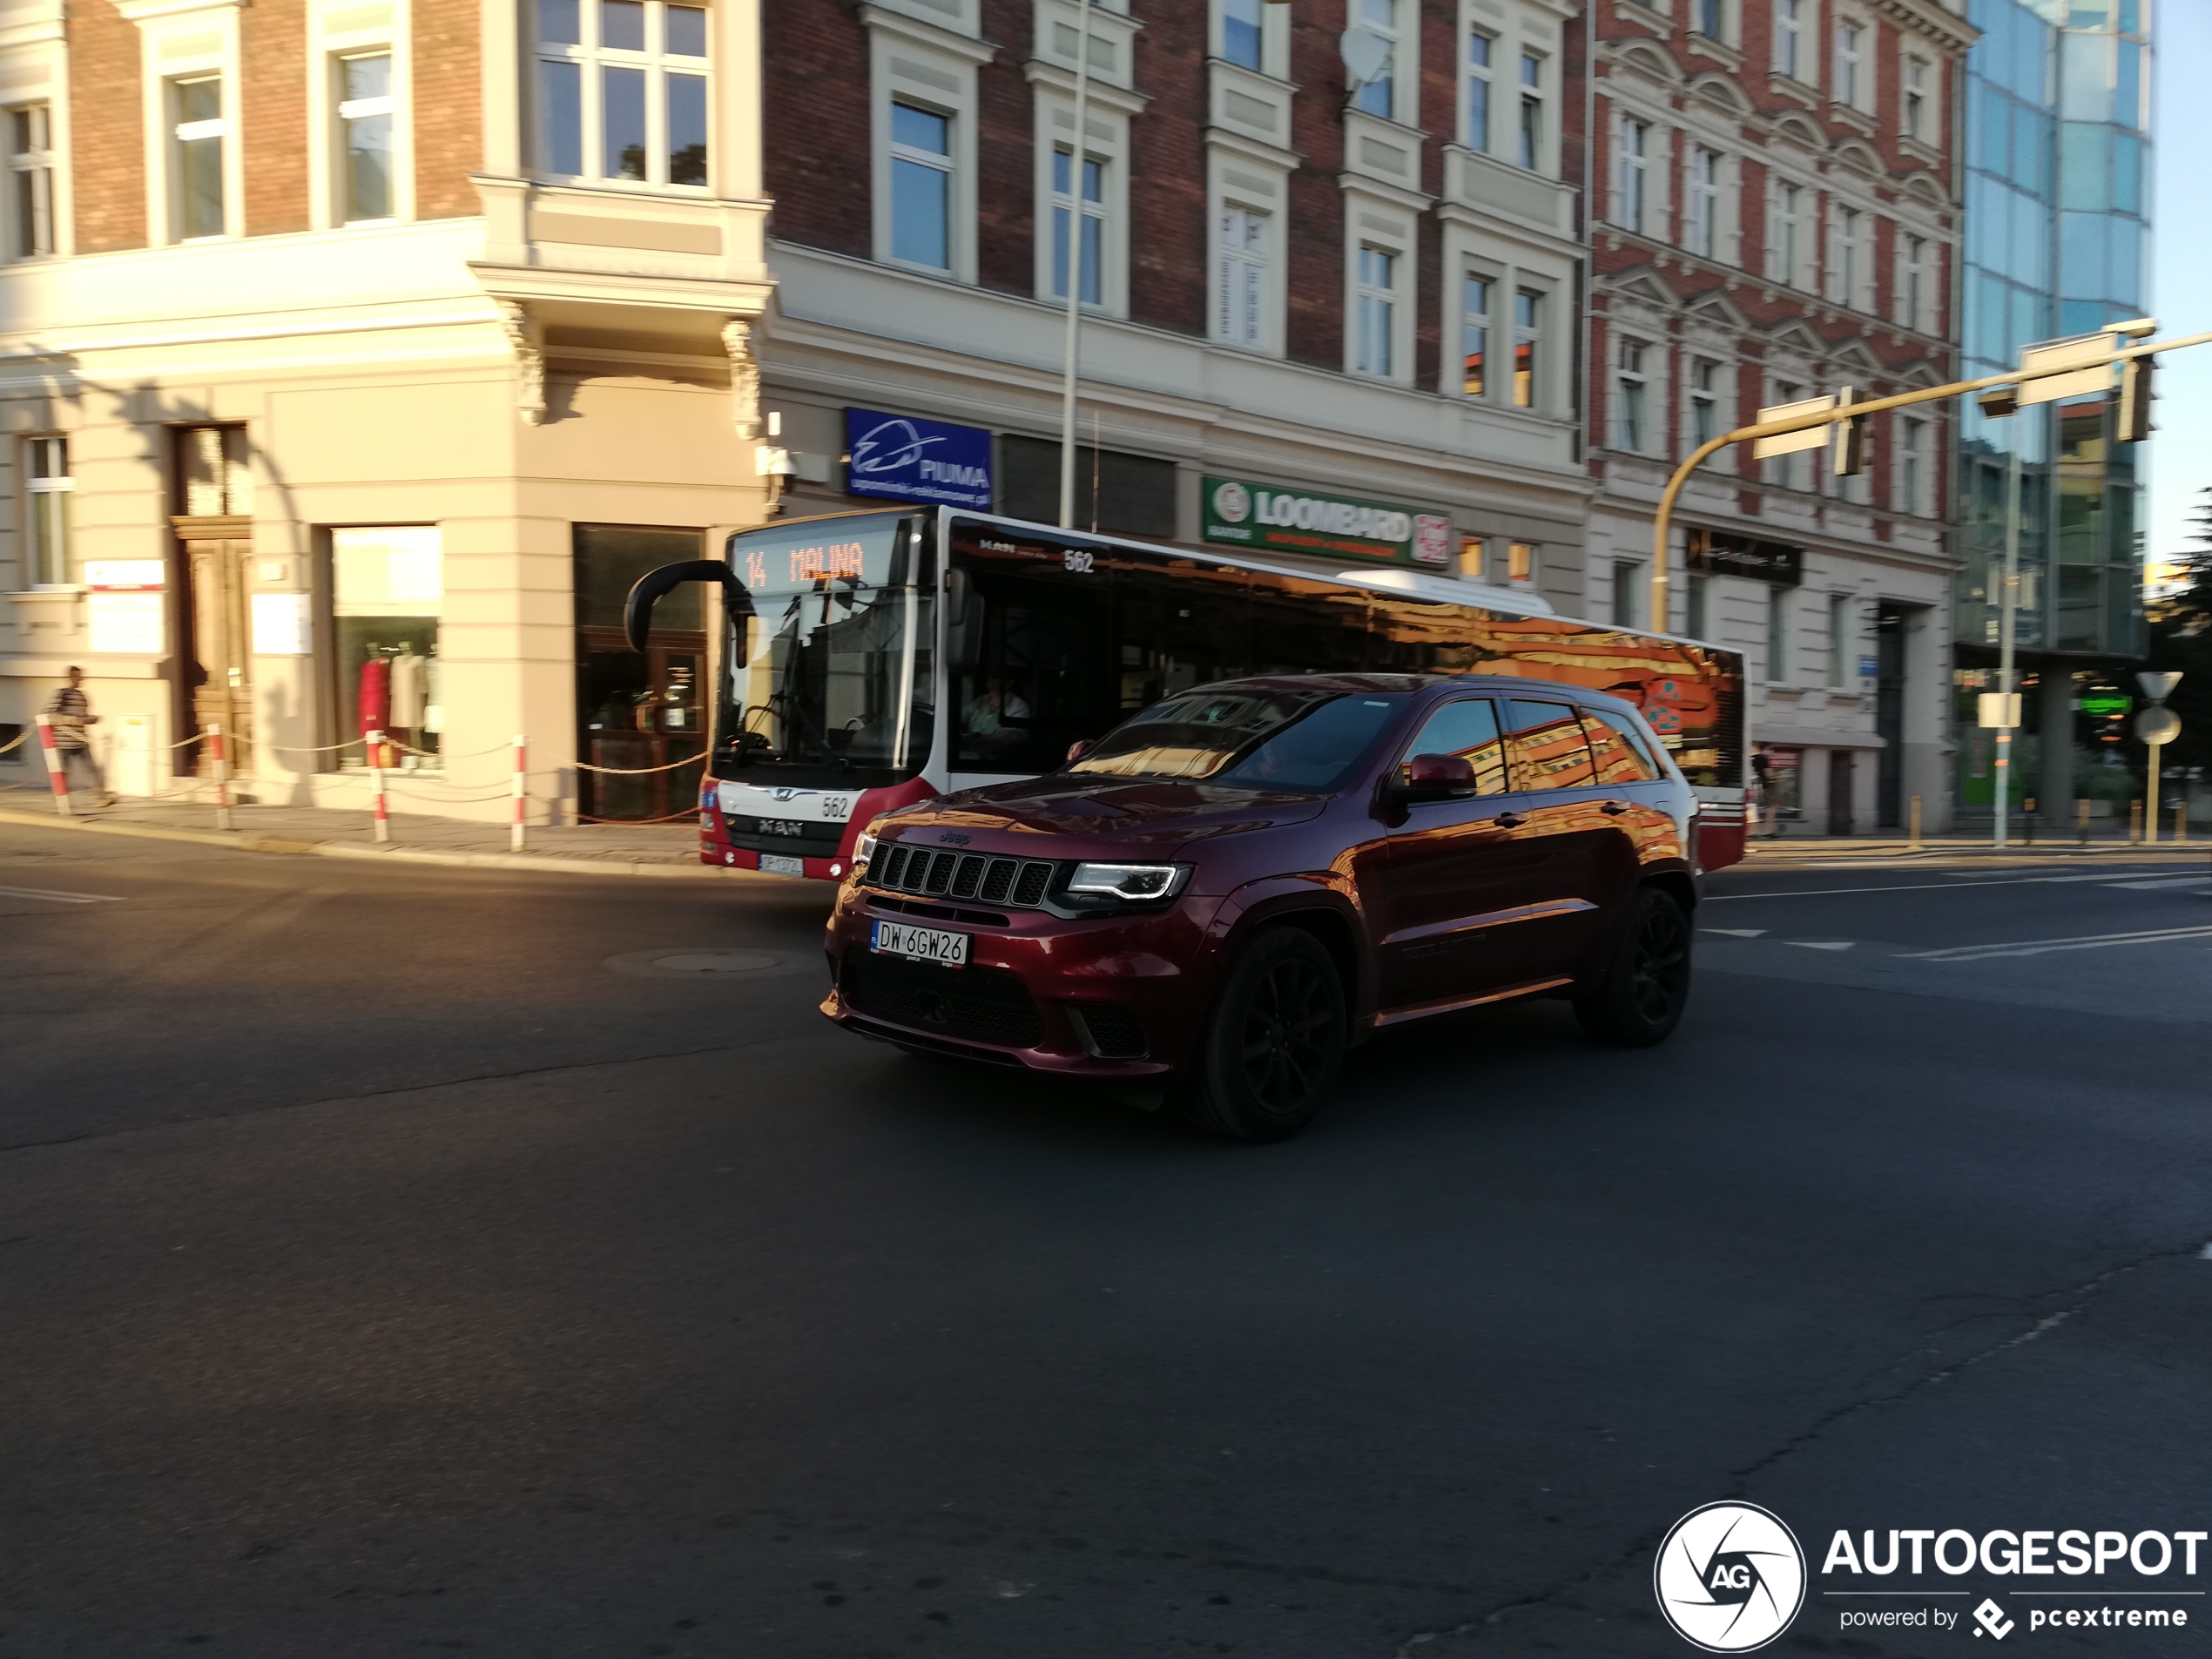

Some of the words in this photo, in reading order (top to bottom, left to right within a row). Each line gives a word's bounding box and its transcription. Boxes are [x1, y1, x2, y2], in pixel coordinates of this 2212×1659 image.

[920, 459, 989, 489] PIUMA
[1254, 491, 1413, 543] LOOMBARD
[745, 551, 766, 588] 14
[790, 542, 864, 582] MALINA
[1063, 550, 1095, 574] 562
[822, 797, 847, 818] 562
[759, 819, 804, 837] MAN
[939, 830, 972, 846] Jeep
[880, 924, 902, 950] DW
[907, 929, 963, 961] 6GW26
